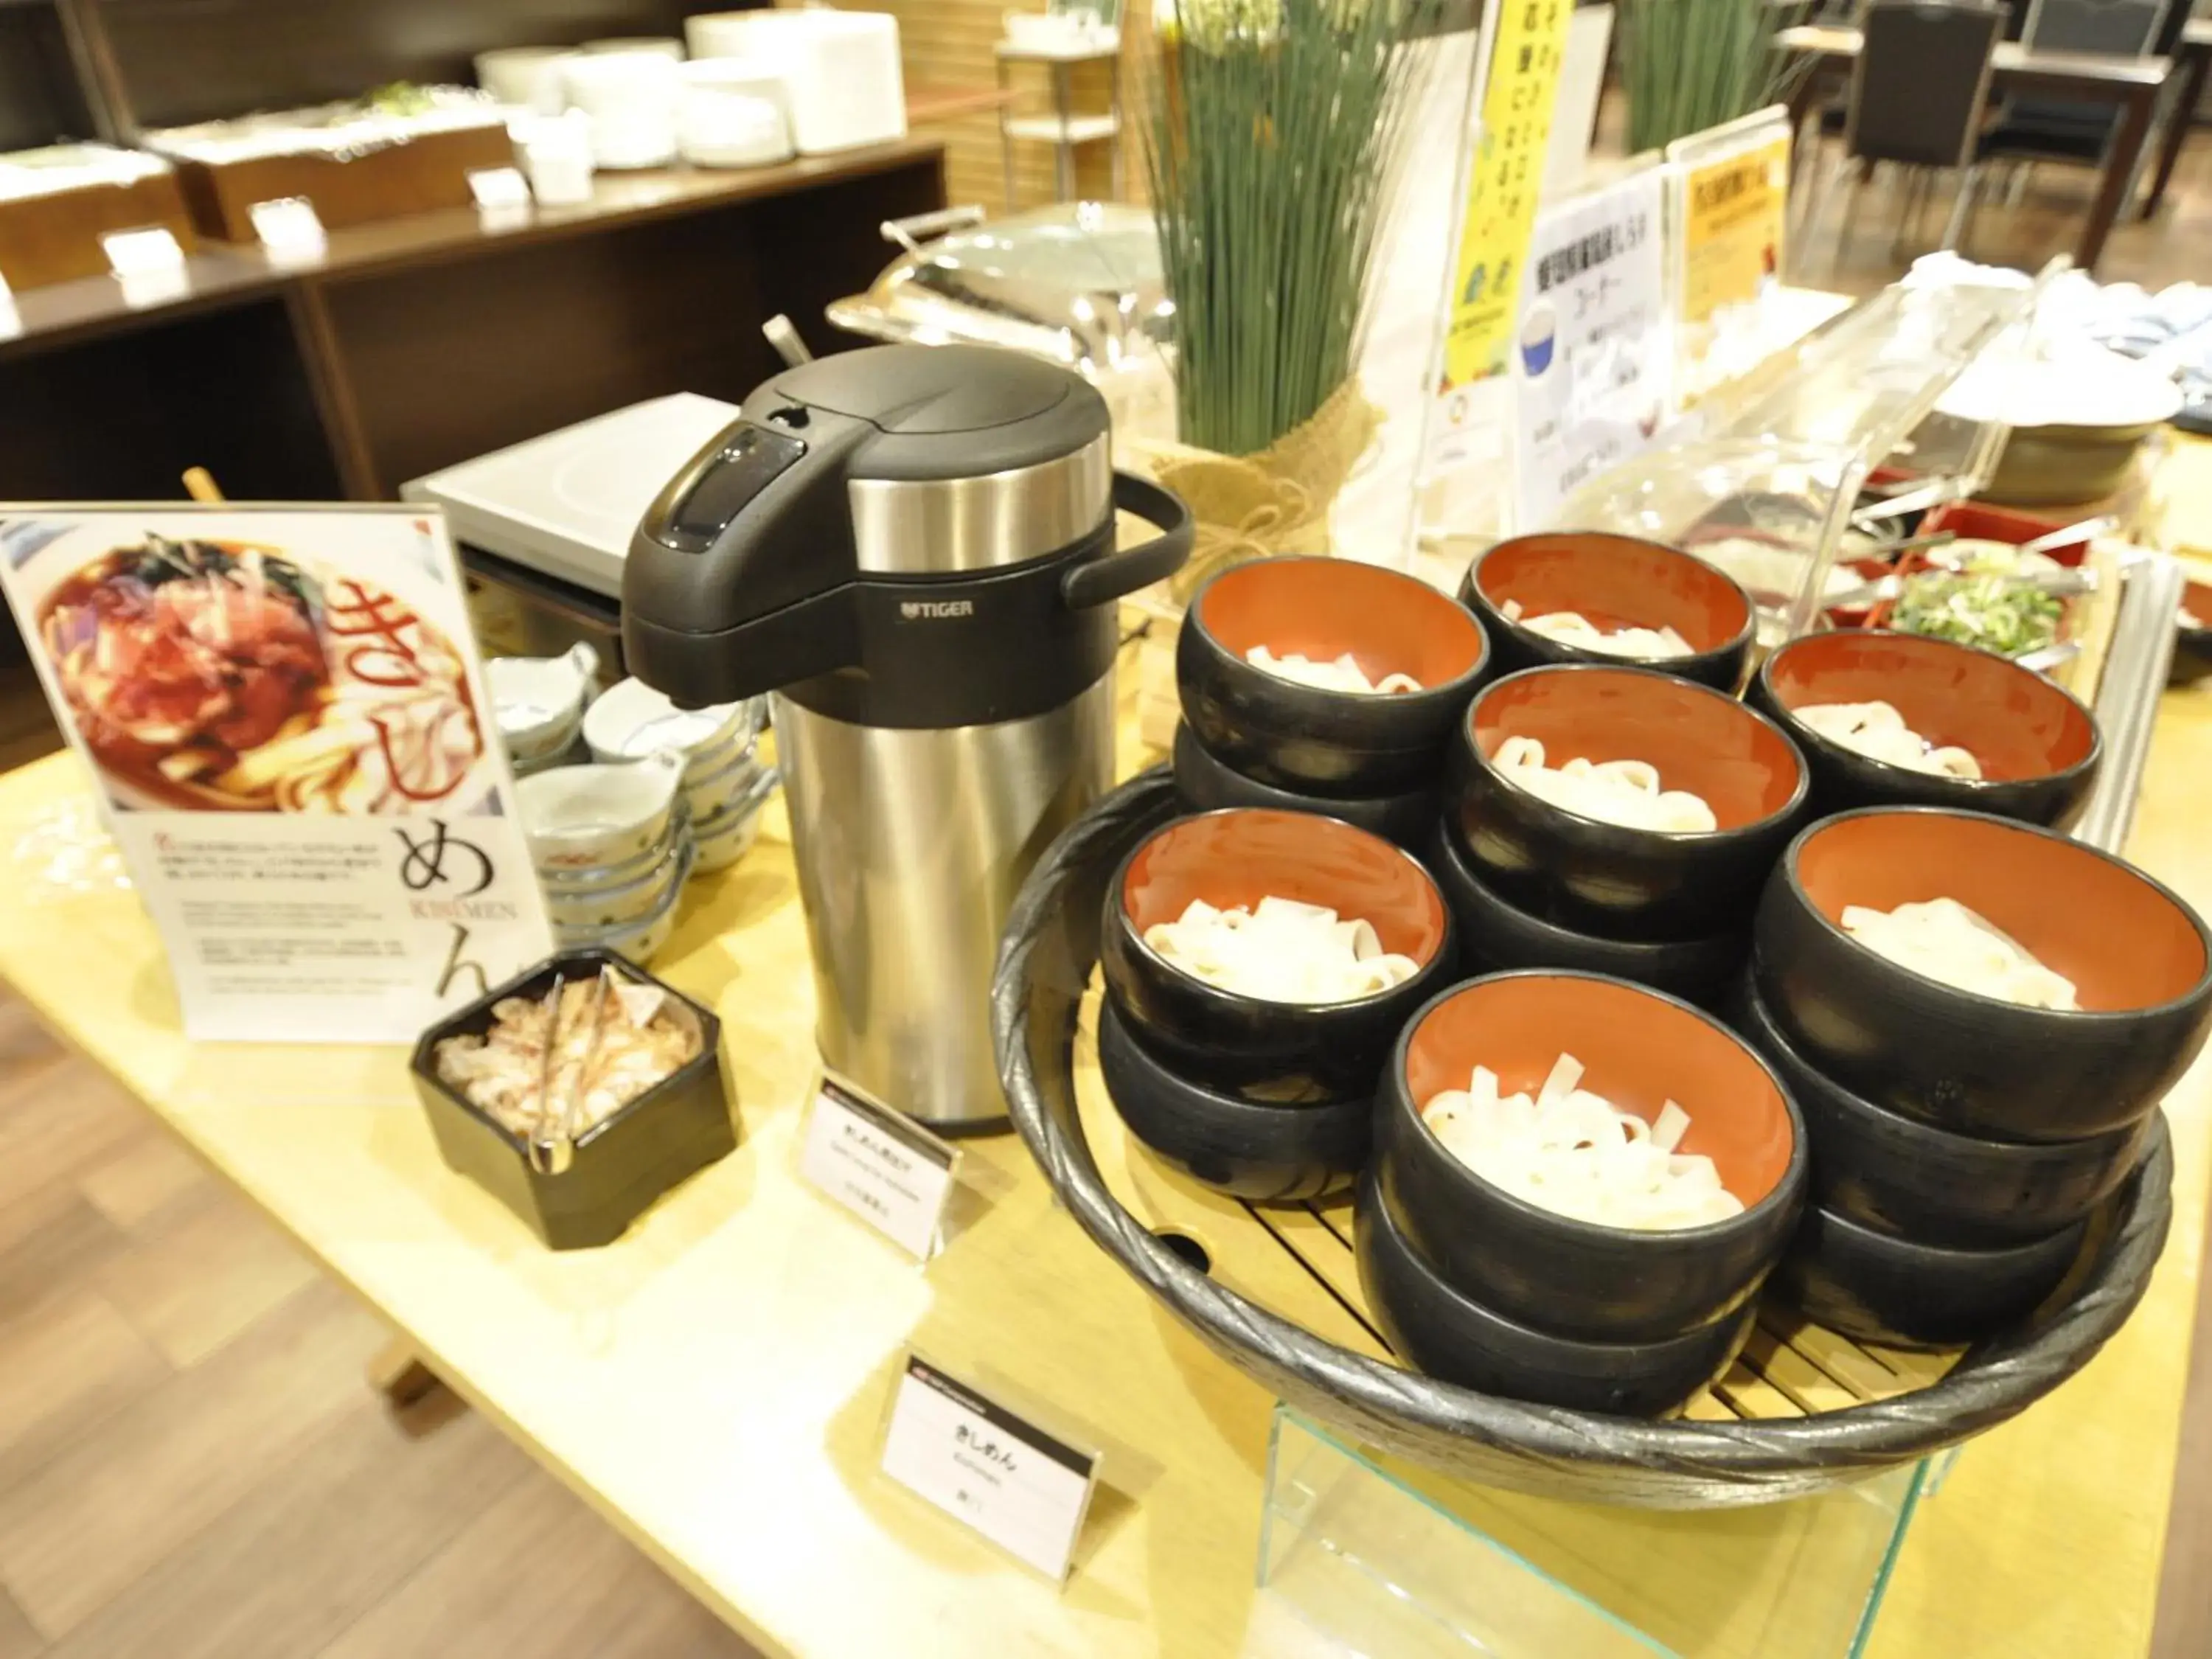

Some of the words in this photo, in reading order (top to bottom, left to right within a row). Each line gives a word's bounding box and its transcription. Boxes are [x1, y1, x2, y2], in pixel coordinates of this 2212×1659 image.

[919, 600, 973, 618] TIGER
[955, 1422, 1018, 1471] きしめん
